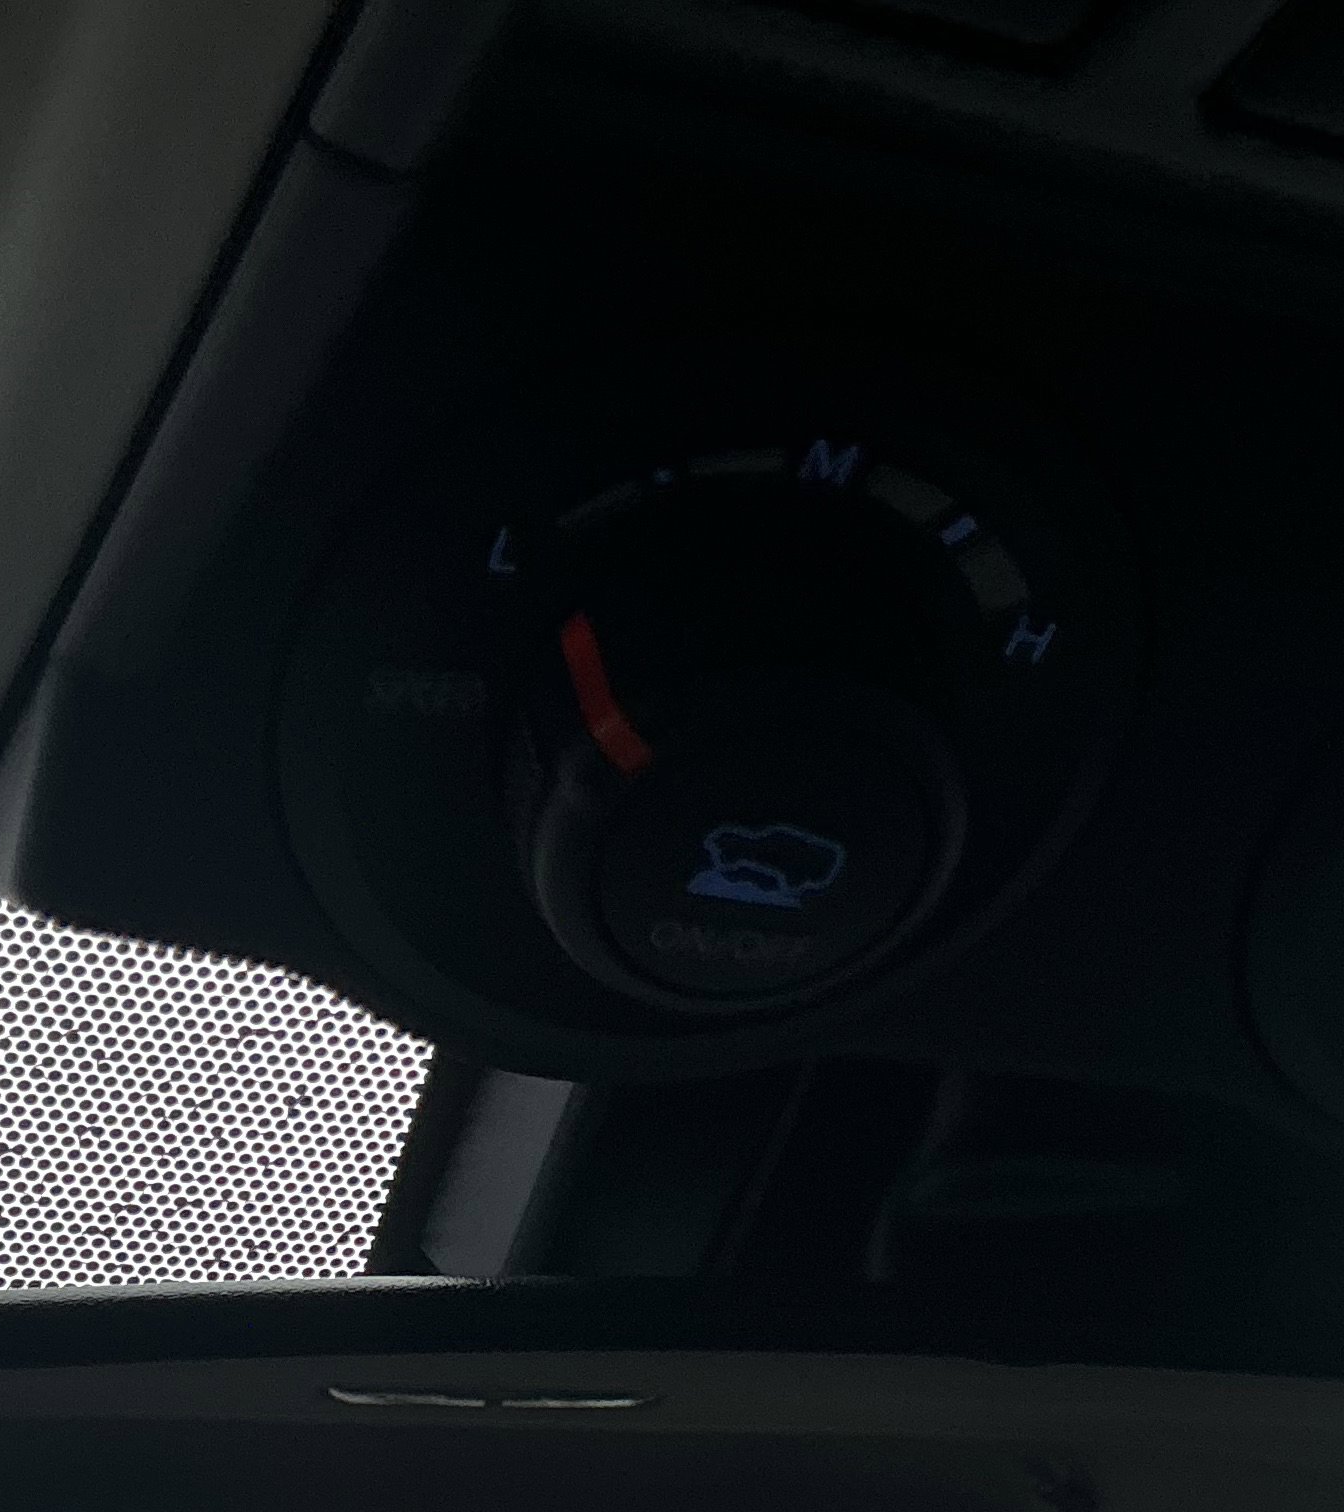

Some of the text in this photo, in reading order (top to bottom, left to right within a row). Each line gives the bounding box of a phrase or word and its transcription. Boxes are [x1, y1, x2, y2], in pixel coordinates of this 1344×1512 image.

[801, 438, 862, 486] M
[486, 525, 517, 575] L
[1004, 614, 1058, 666] H
